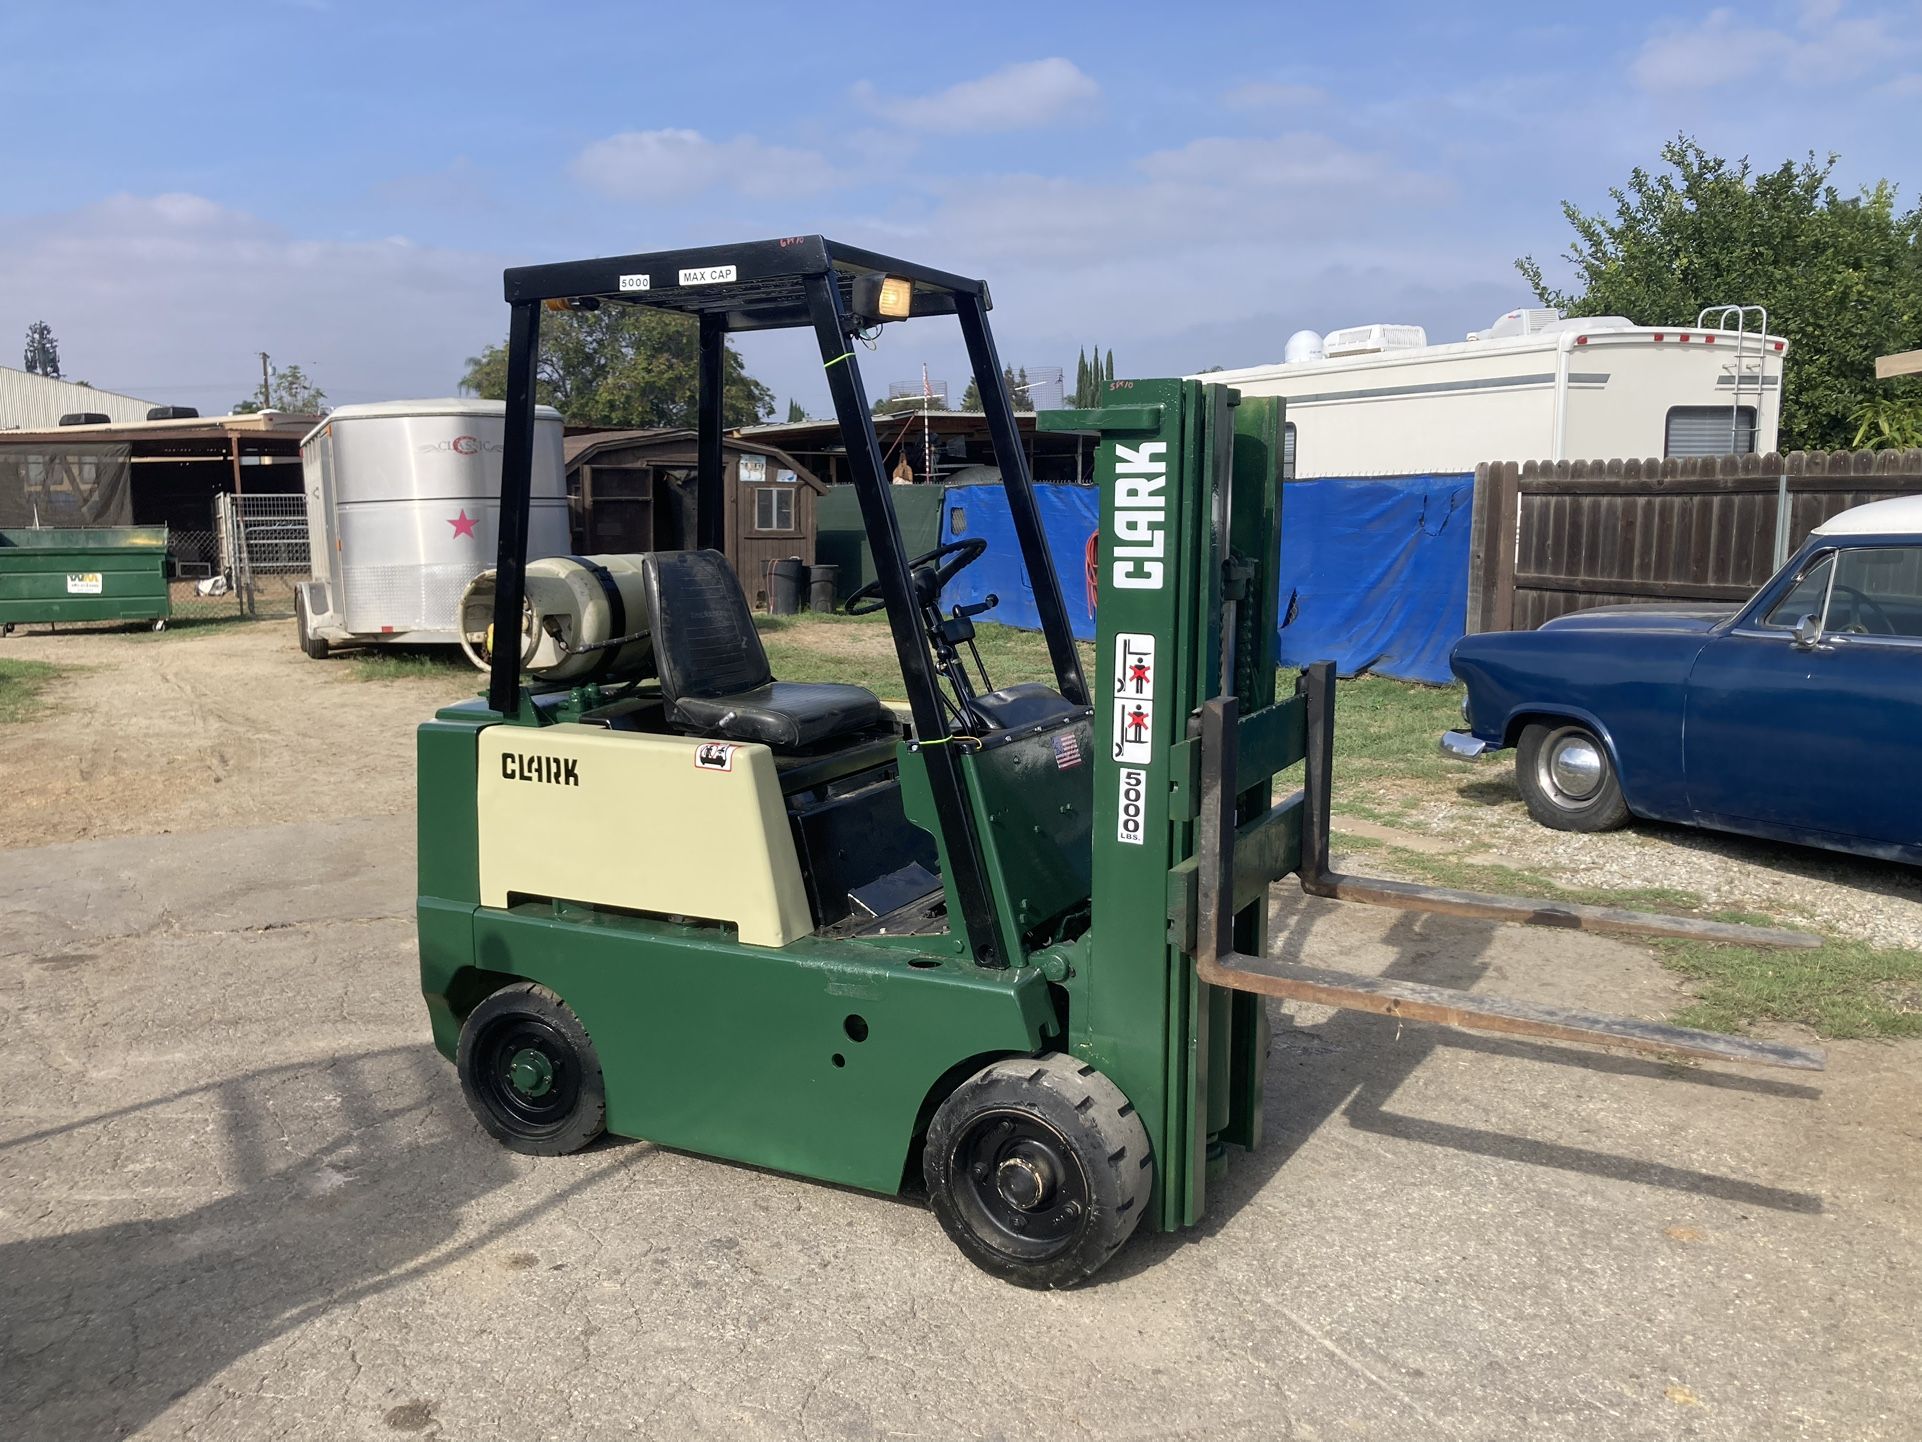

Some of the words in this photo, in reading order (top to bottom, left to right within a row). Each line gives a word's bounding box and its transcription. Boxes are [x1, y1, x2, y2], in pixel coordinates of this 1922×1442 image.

[621, 278, 649, 288] 5000
[683, 271, 706, 282] MAX
[710, 269, 732, 280] CAP
[1113, 441, 1167, 589] CLARK
[501, 752, 579, 786] CLARK
[1122, 771, 1142, 833] 5000
[1120, 832, 1141, 841] LBS.
